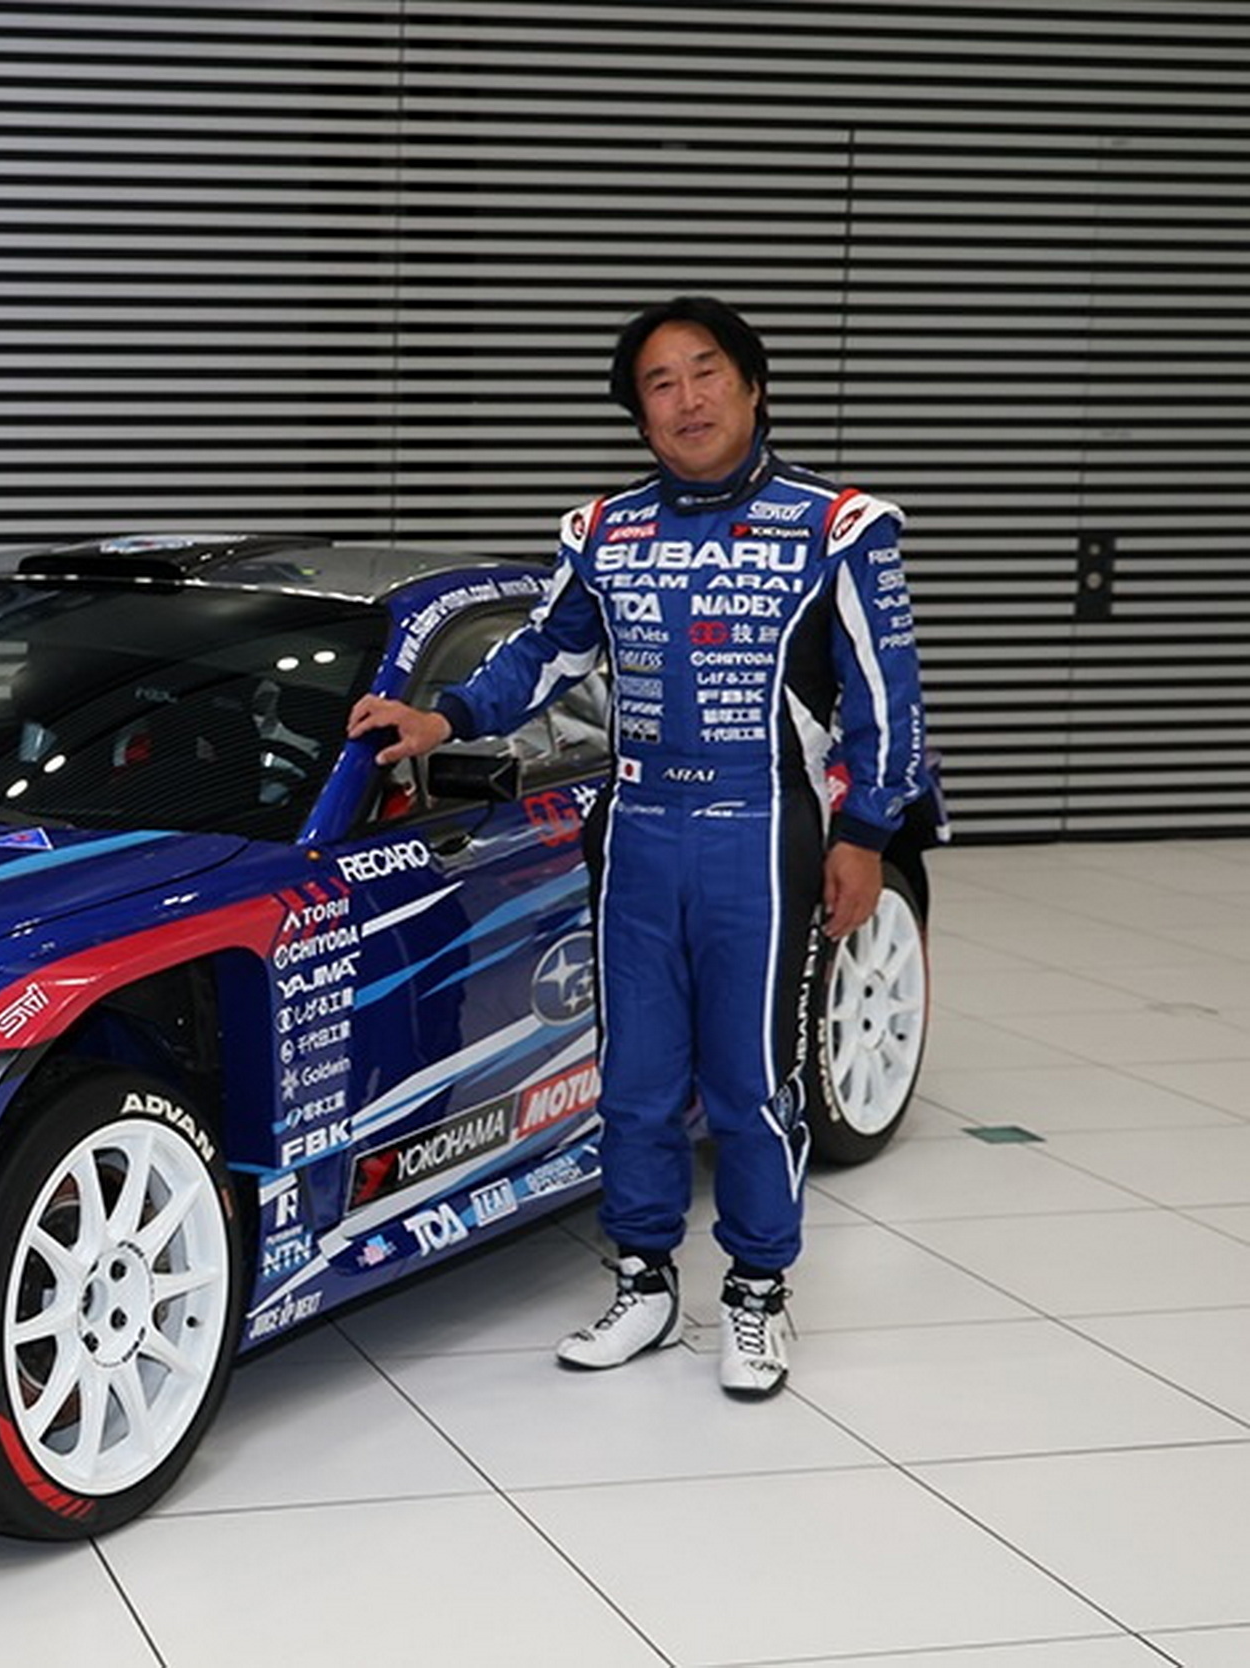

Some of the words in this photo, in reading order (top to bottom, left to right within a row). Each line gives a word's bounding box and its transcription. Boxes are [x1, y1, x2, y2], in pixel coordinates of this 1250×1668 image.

[595, 541, 807, 572] SUBARU
[595, 574, 689, 590] TEAM
[707, 574, 803, 594] ARAI
[611, 593, 663, 623] TOA
[690, 595, 782, 618] NADEX
[696, 689, 765, 703] FBK
[662, 767, 716, 782] ARAI
[337, 840, 431, 882] RECARO
[288, 924, 360, 963] CHIYODA
[276, 951, 362, 999] YAJIMA
[301, 1057, 351, 1086] Goldwin
[120, 1093, 216, 1162] ADVAN
[281, 1117, 351, 1168] FBK
[396, 1109, 505, 1180] YOKOHAMA
[403, 1203, 469, 1257] TOA
